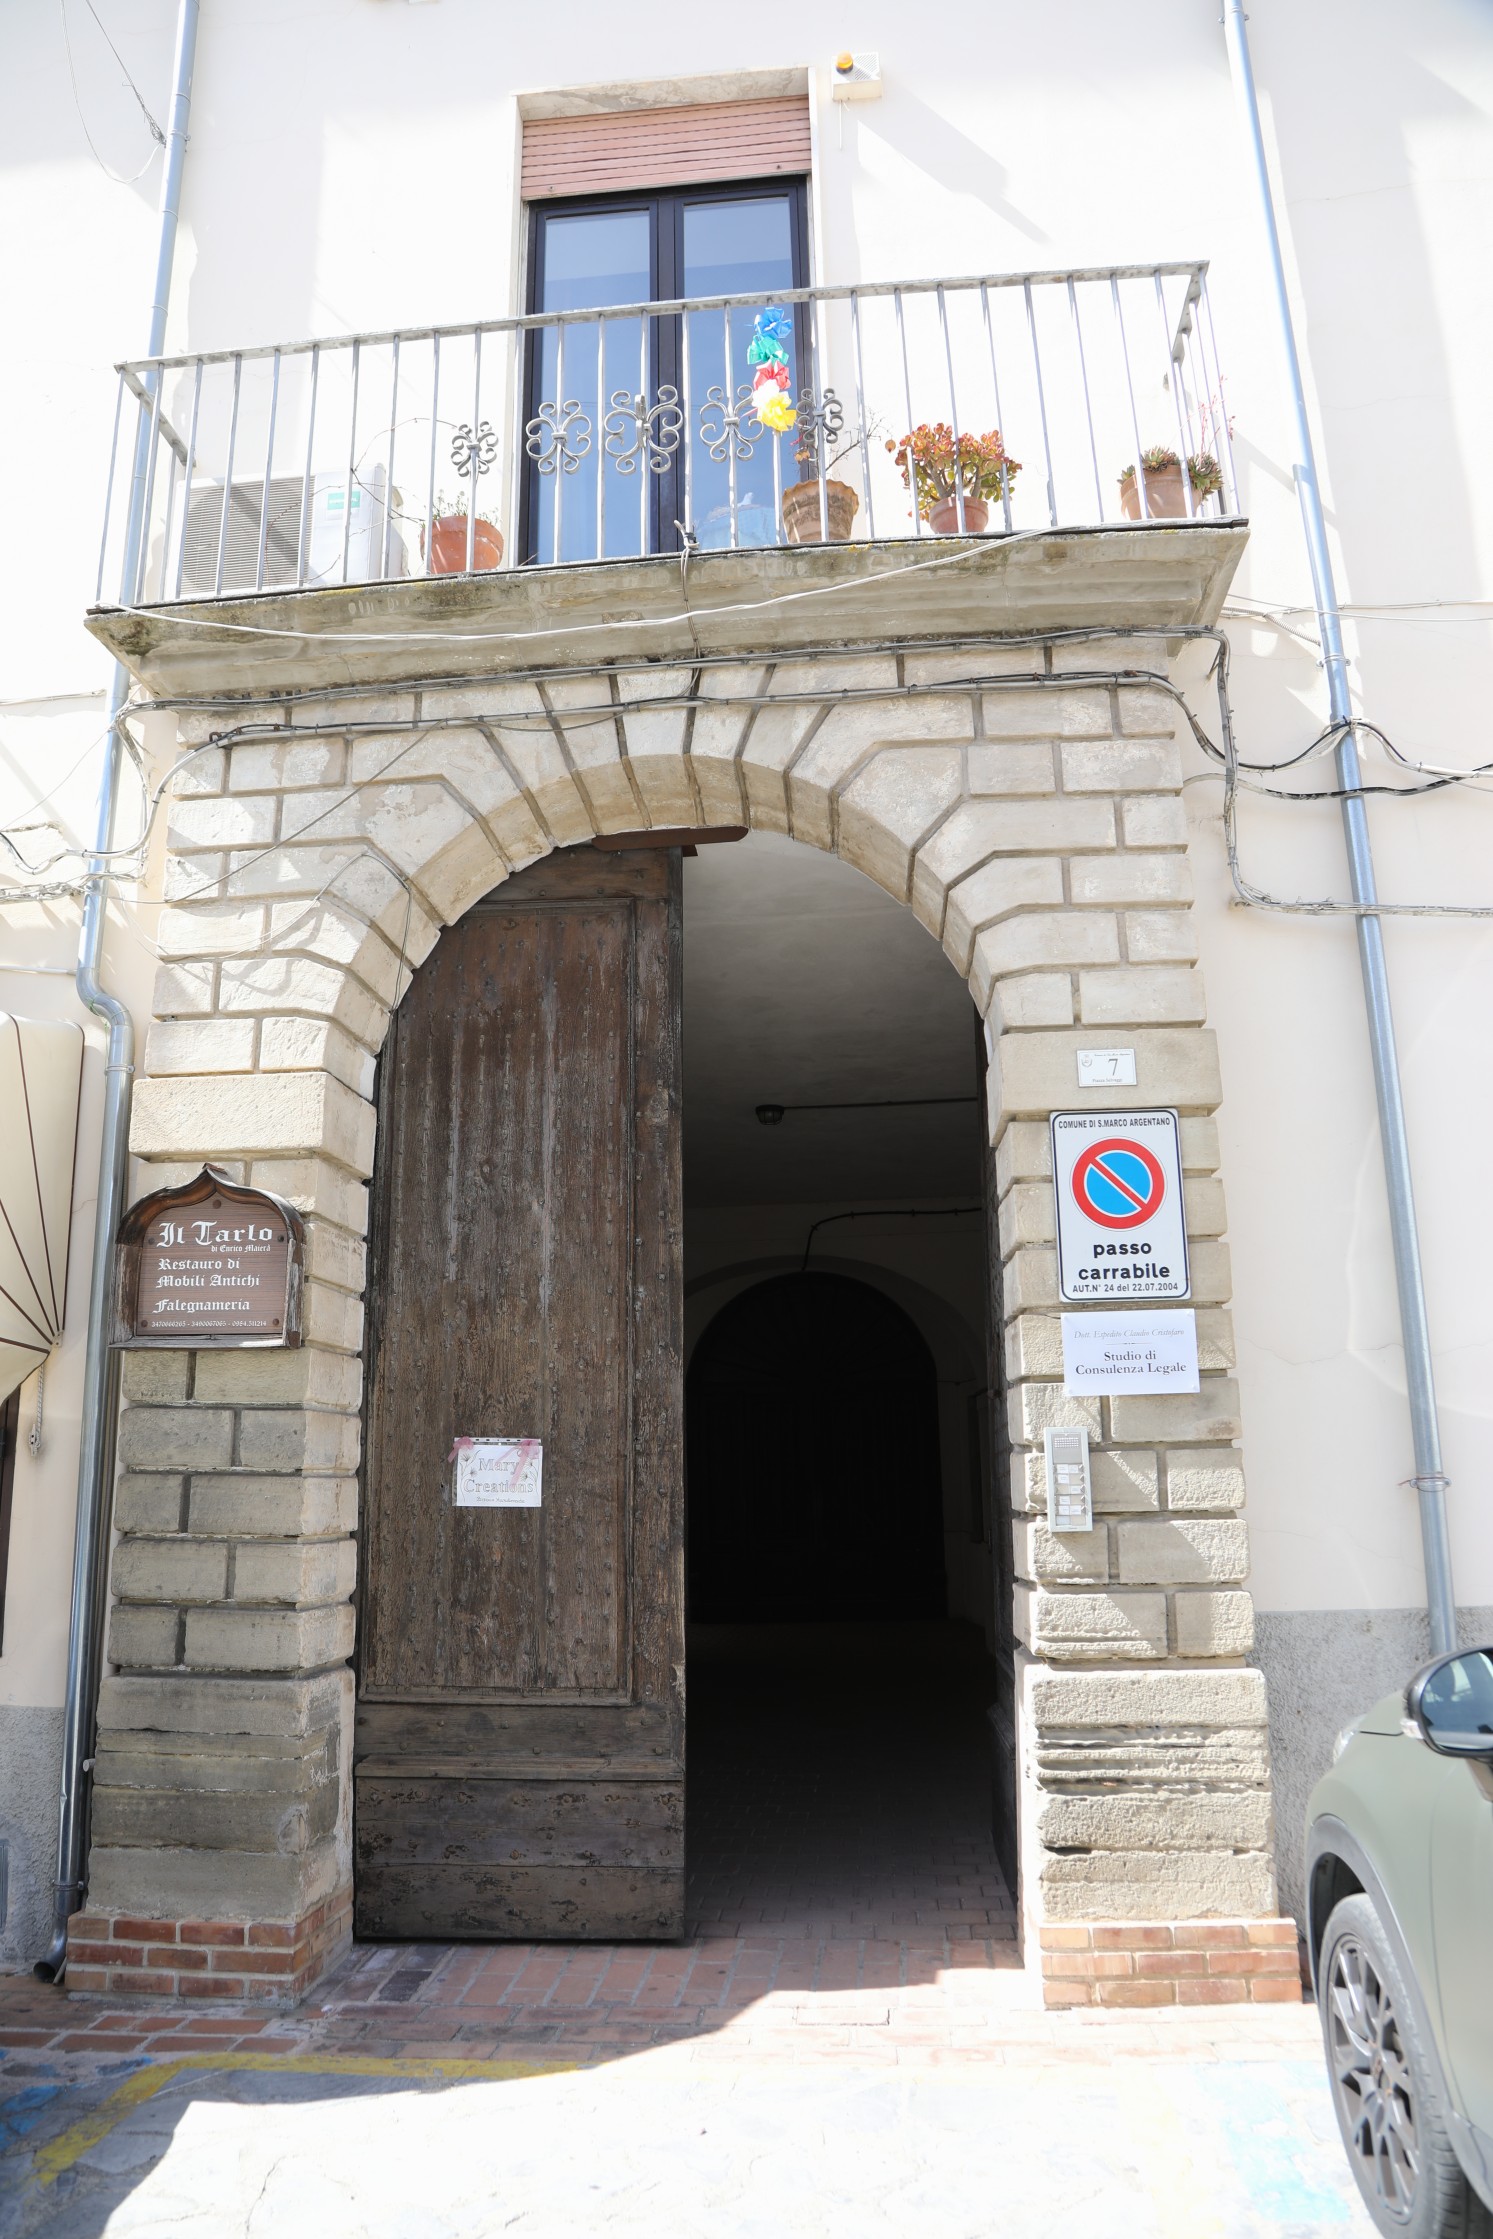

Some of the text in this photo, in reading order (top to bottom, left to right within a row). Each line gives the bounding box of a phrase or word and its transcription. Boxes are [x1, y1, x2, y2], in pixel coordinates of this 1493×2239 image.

[1108, 1058, 1118, 1076] 7
[1058, 1117, 1171, 1129] COMUNE DI S.MARCO ARGENTANO
[156, 1221, 273, 1247] Il Tarlo
[211, 1244, 218, 1252] di
[219, 1244, 243, 1252] Enrico
[1093, 1242, 1152, 1259] passo
[158, 1258, 240, 1270] Restauro di
[1078, 1262, 1170, 1280] carrabile
[156, 1274, 260, 1288] Mobili Antichi
[1104, 1284, 1115, 1292] 24
[1116, 1284, 1130, 1292] del
[1132, 1282, 1178, 1292] 22.07.2004
[152, 1299, 250, 1313] Falegnameria
[1074, 1330, 1091, 1339] Dott.
[1123, 1328, 1150, 1337] Claudio
[1151, 1327, 1185, 1338] Cristofaro
[1104, 1350, 1157, 1362] Studio di
[1075, 1362, 1187, 1375] Consulenza Legale
[478, 1457, 520, 1475] Mary
[464, 1478, 534, 1494] Creations
